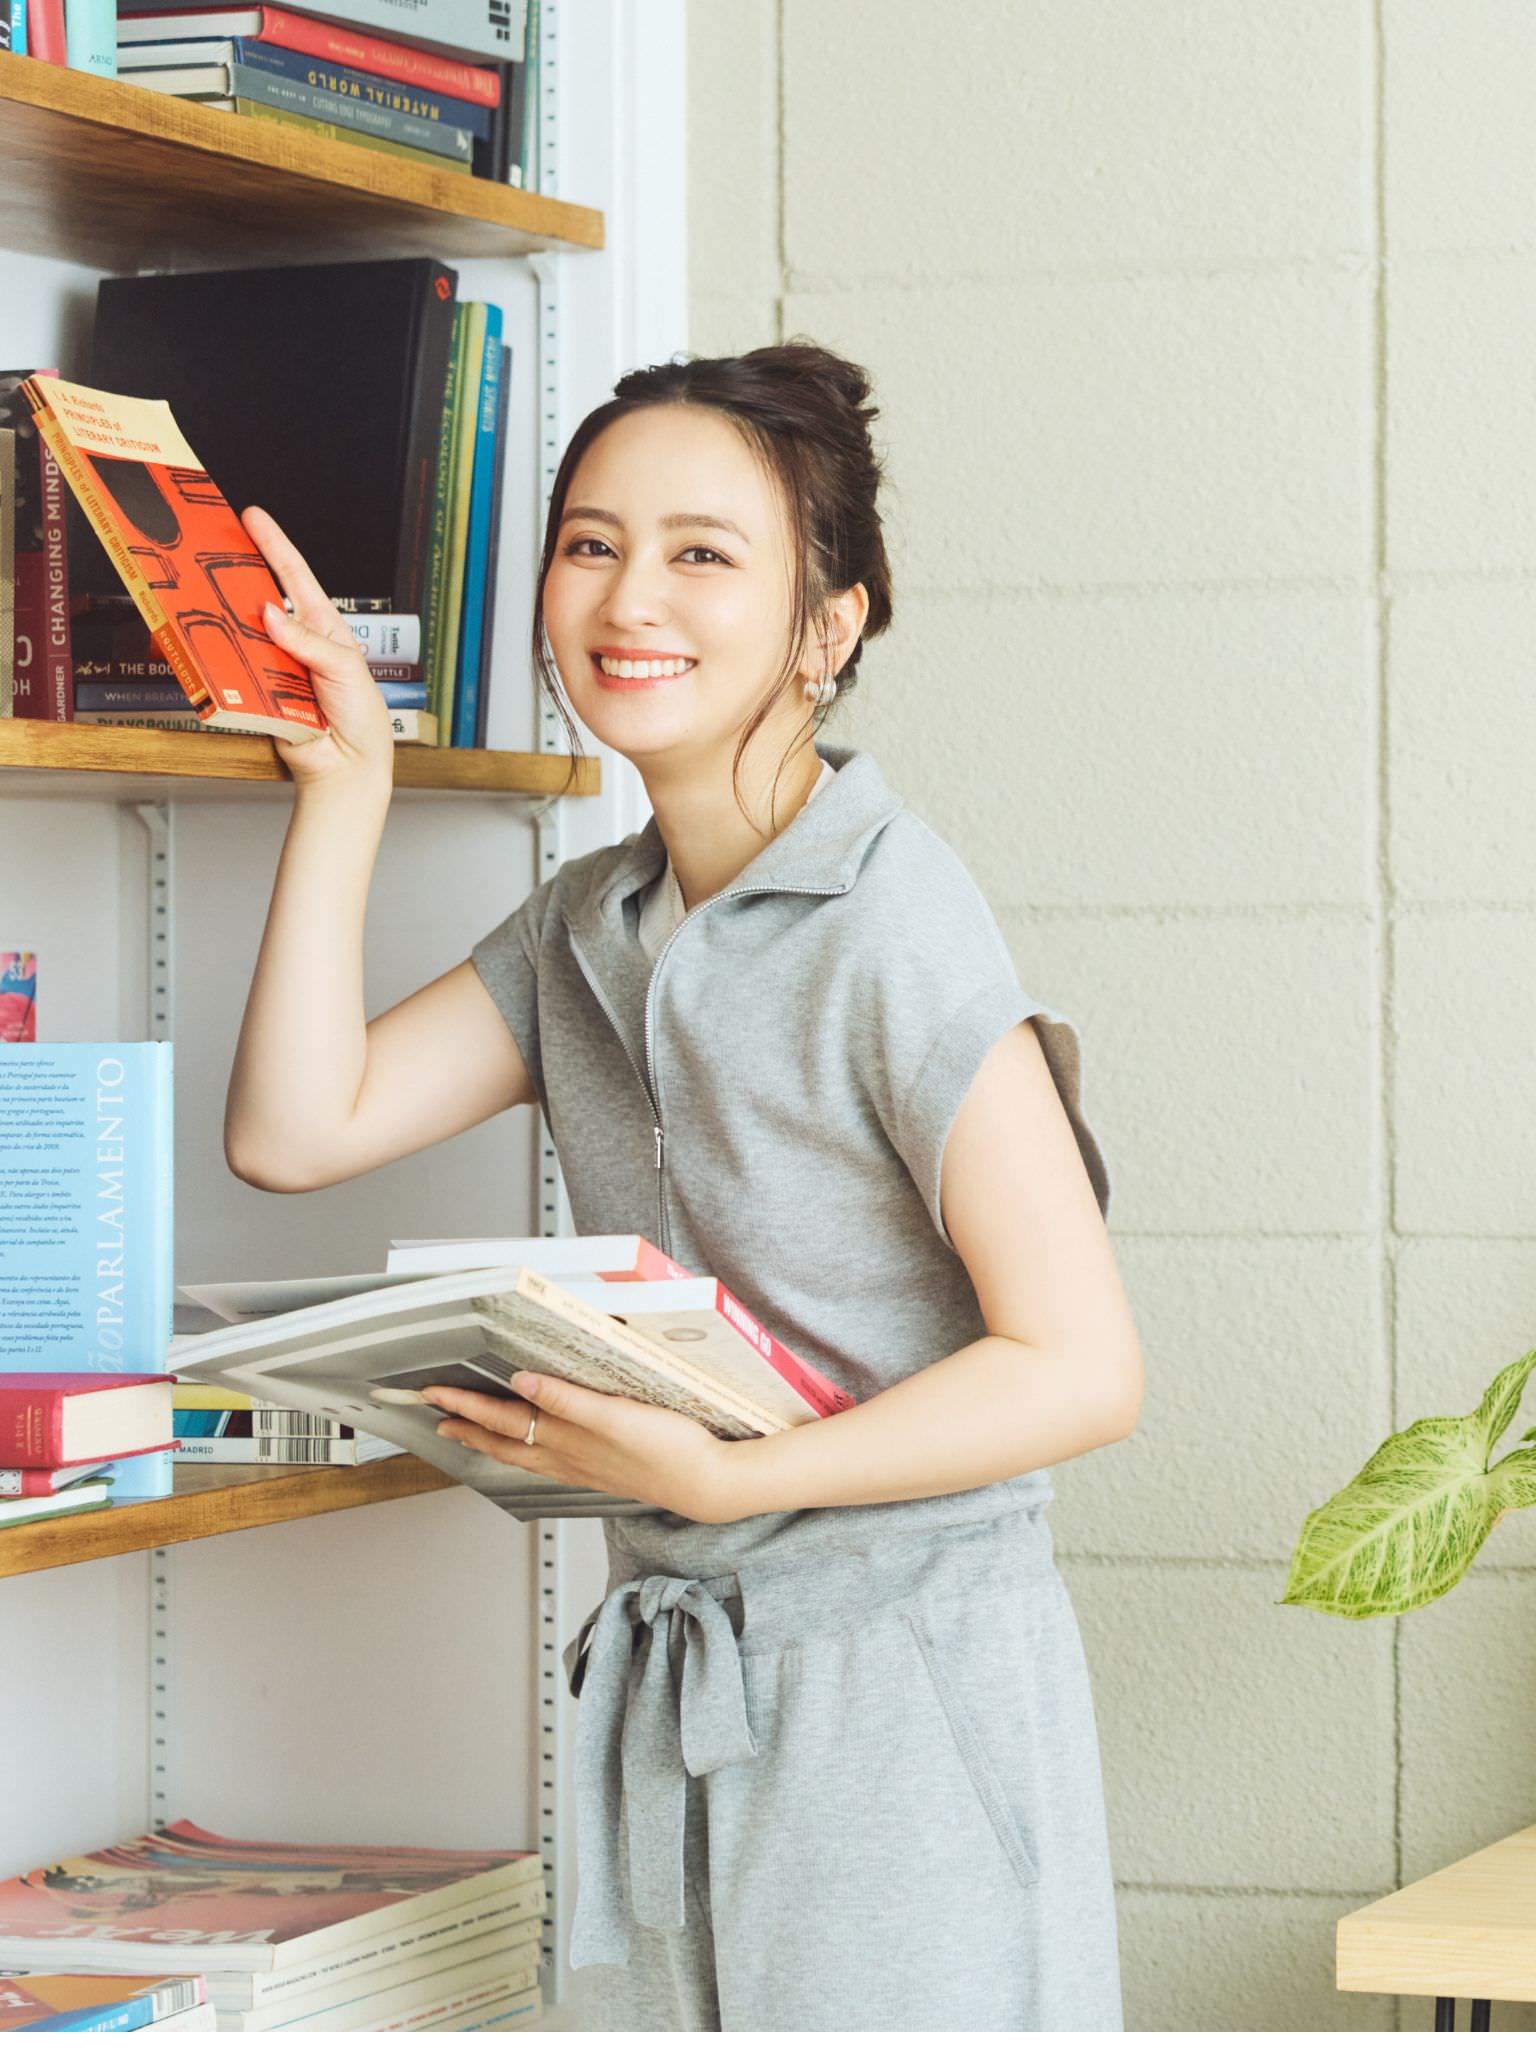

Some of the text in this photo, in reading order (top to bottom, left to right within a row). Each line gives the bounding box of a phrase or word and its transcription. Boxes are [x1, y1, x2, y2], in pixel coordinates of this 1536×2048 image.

[307, 69, 360, 97] WORLD
[366, 85, 439, 121] MATERIAL
[62, 408, 113, 431] PRINCIPLES
[73, 426, 162, 454] LITERARY CRITICISM
[45, 447, 66, 646] CHANGING MINDS
[52, 431, 84, 482] PRINCIPLES
[85, 495, 113, 540] LITERARY
[108, 532, 138, 582] CRITICISM
[159, 630, 197, 691] ROUTLEDGE
[391, 626, 400, 655] Tuttle
[119, 663, 145, 676] THE
[371, 668, 404, 677] TUTTLE
[55, 665, 67, 723] GARDNER
[104, 691, 141, 702] WHEN
[723, 1293, 772, 1358] WINNING GO
[179, 1444, 215, 1455] MADRID
